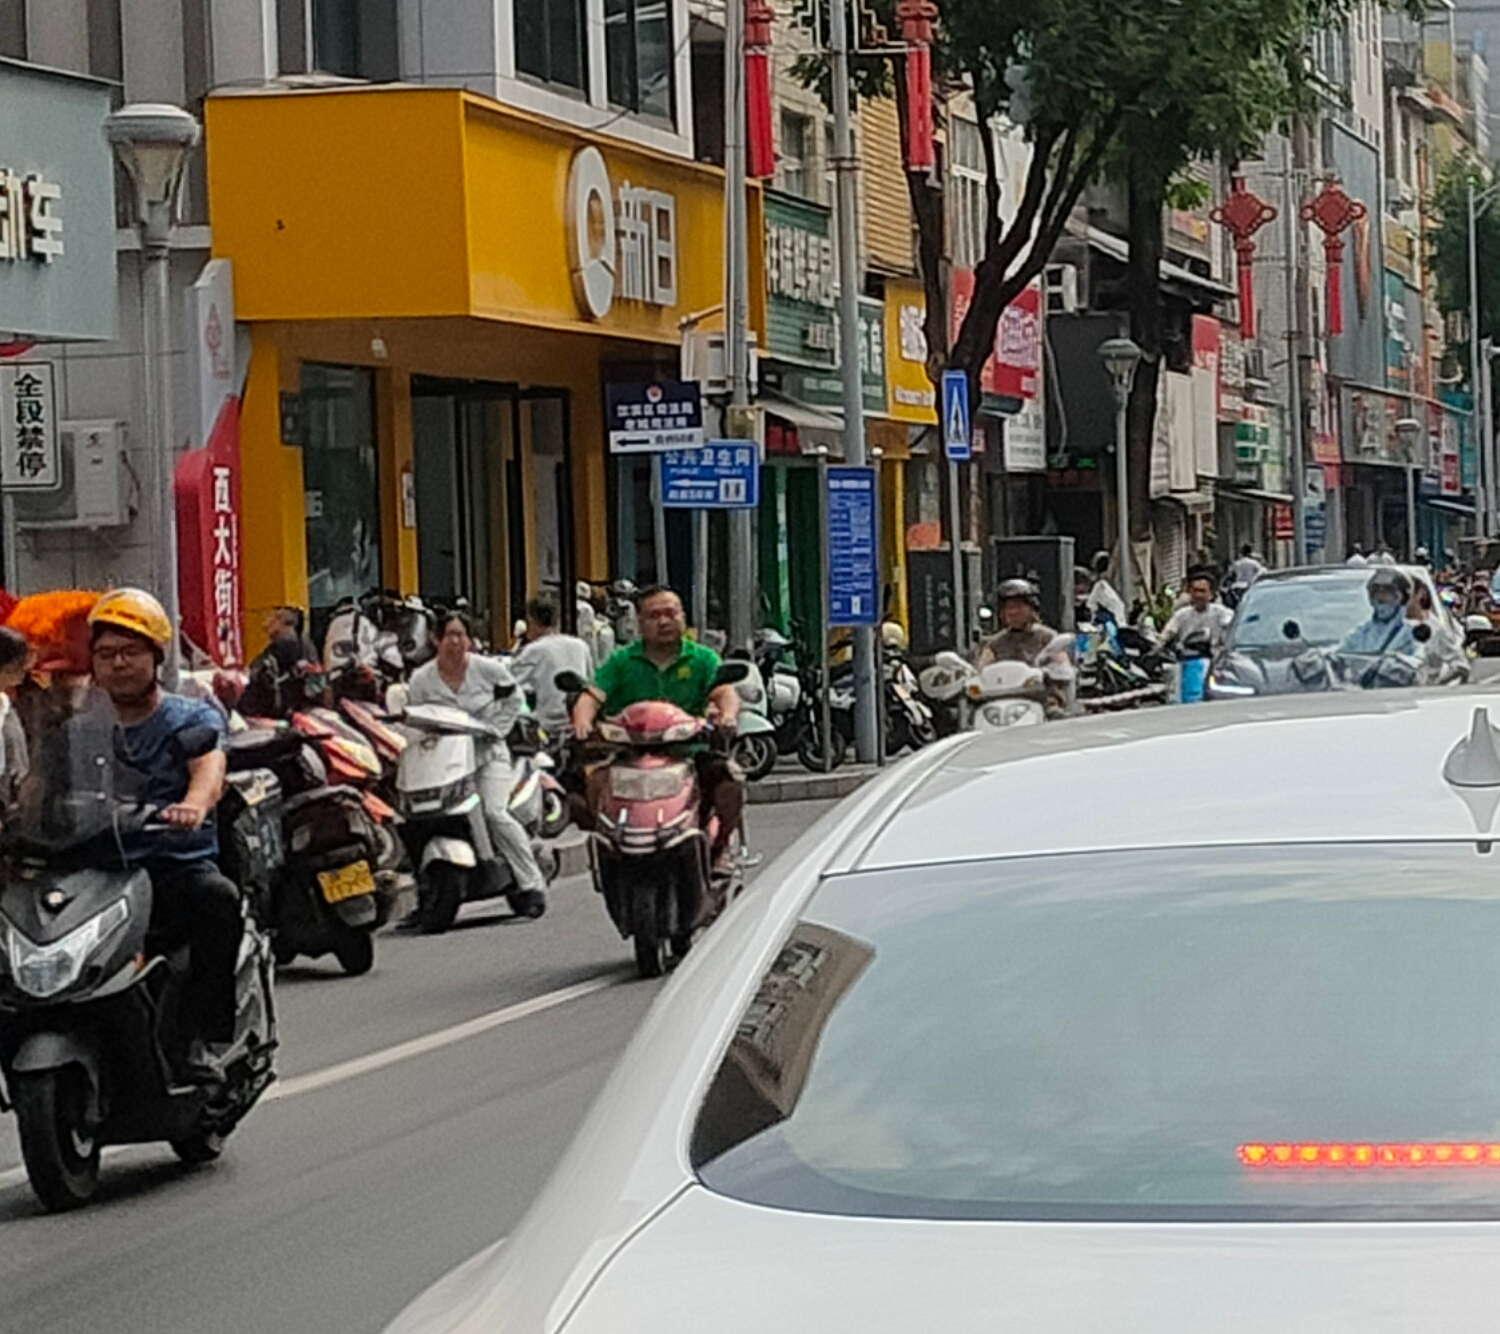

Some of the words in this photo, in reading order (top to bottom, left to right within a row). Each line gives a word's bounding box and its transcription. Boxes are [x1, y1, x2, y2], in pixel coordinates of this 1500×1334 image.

[618, 179, 677, 307] 新日
[14, 372, 47, 478] 全段禁停
[664, 448, 751, 467] 公共卫生间
